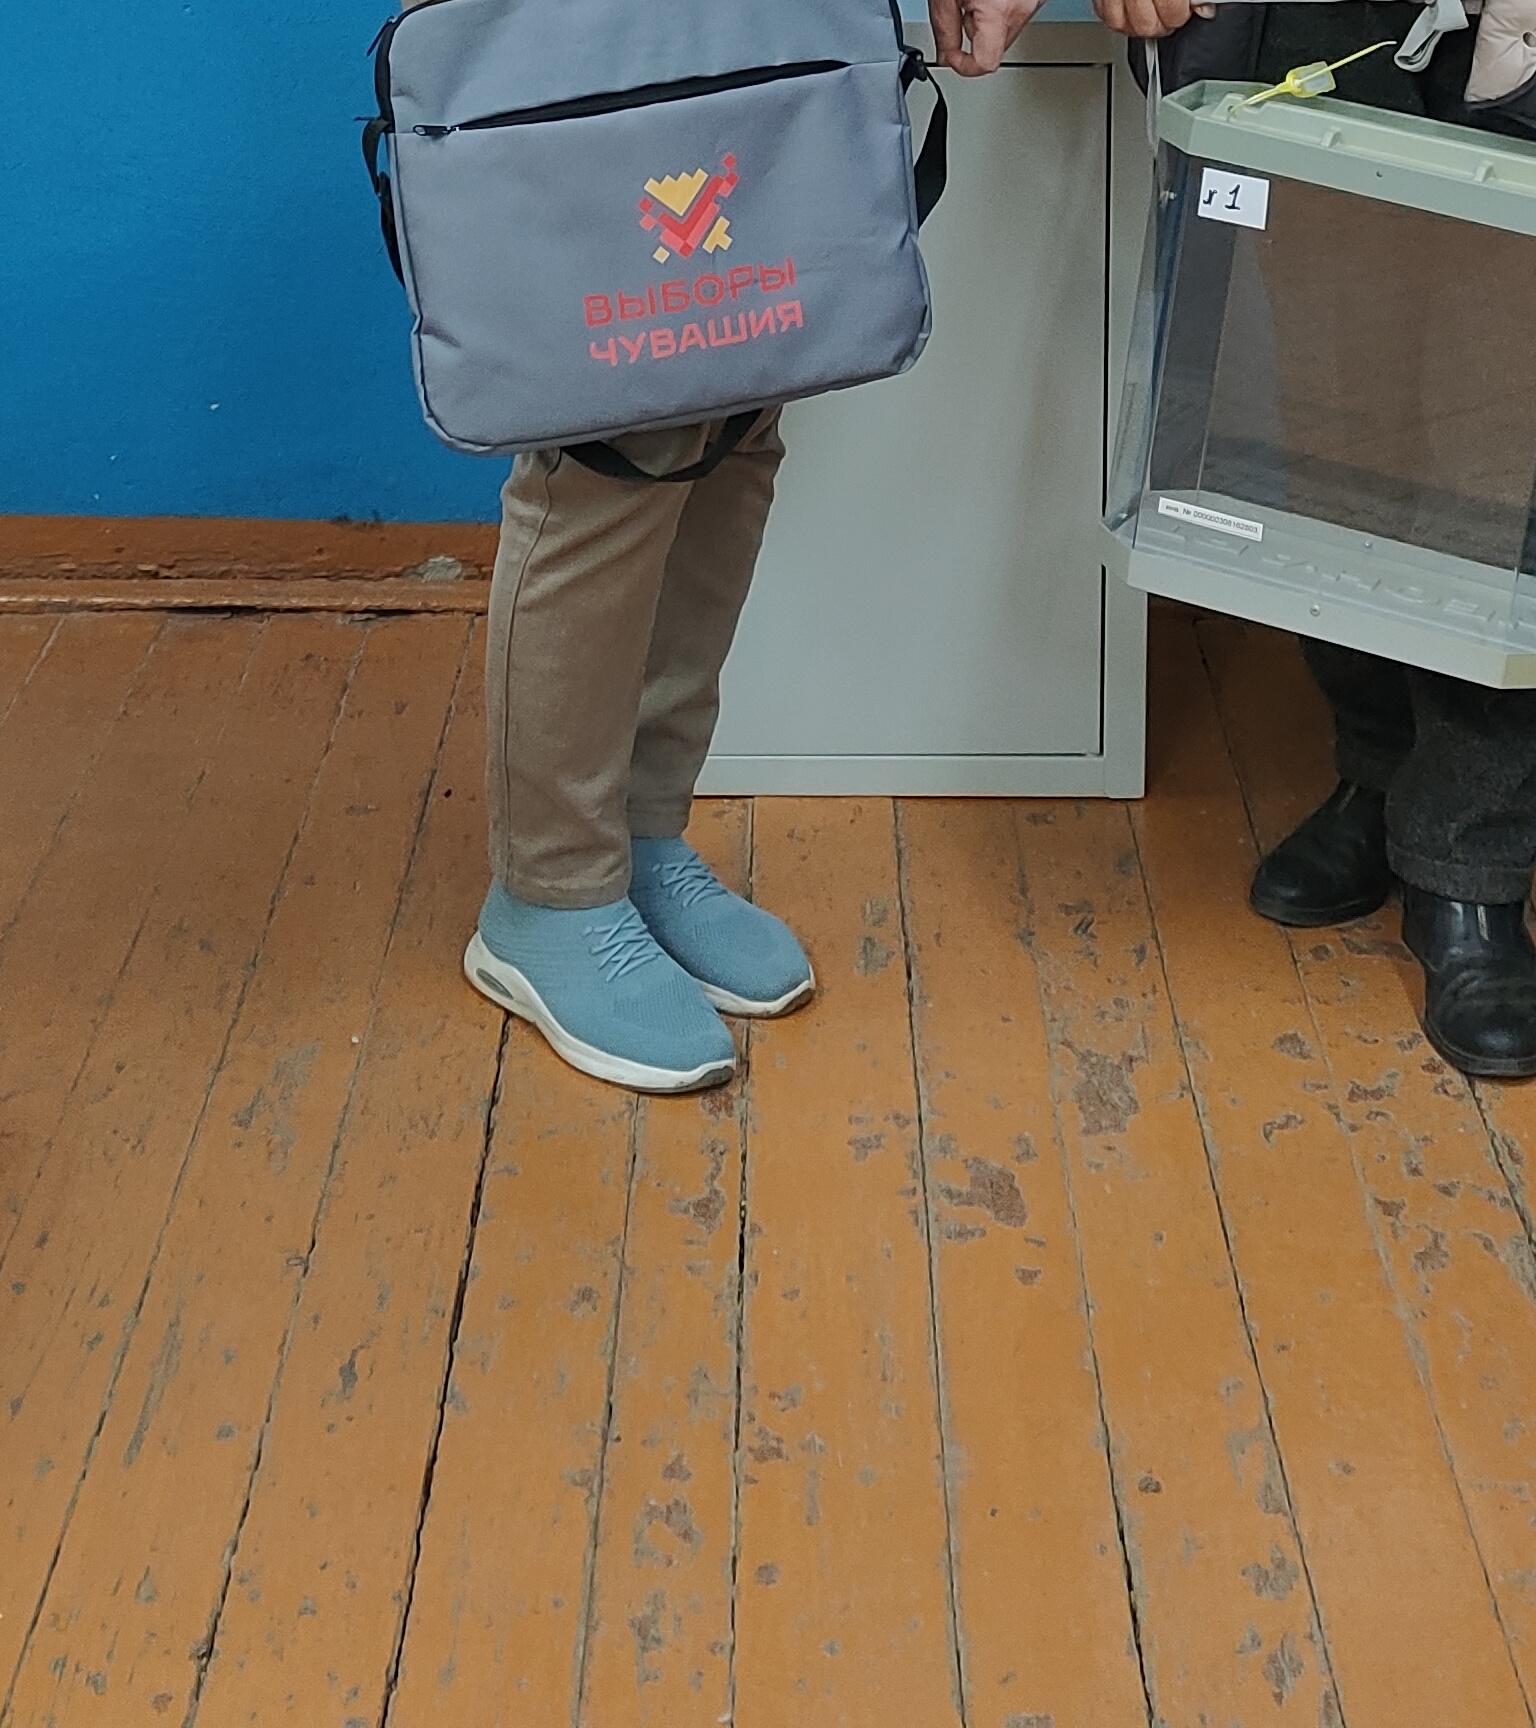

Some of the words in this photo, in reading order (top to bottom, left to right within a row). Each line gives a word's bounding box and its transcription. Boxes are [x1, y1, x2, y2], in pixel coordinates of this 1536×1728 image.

[1224, 184, 1241, 211] 1
[583, 256, 796, 328] ВЫБОРЫ
[588, 299, 805, 368] ЧУВАШИЯ
